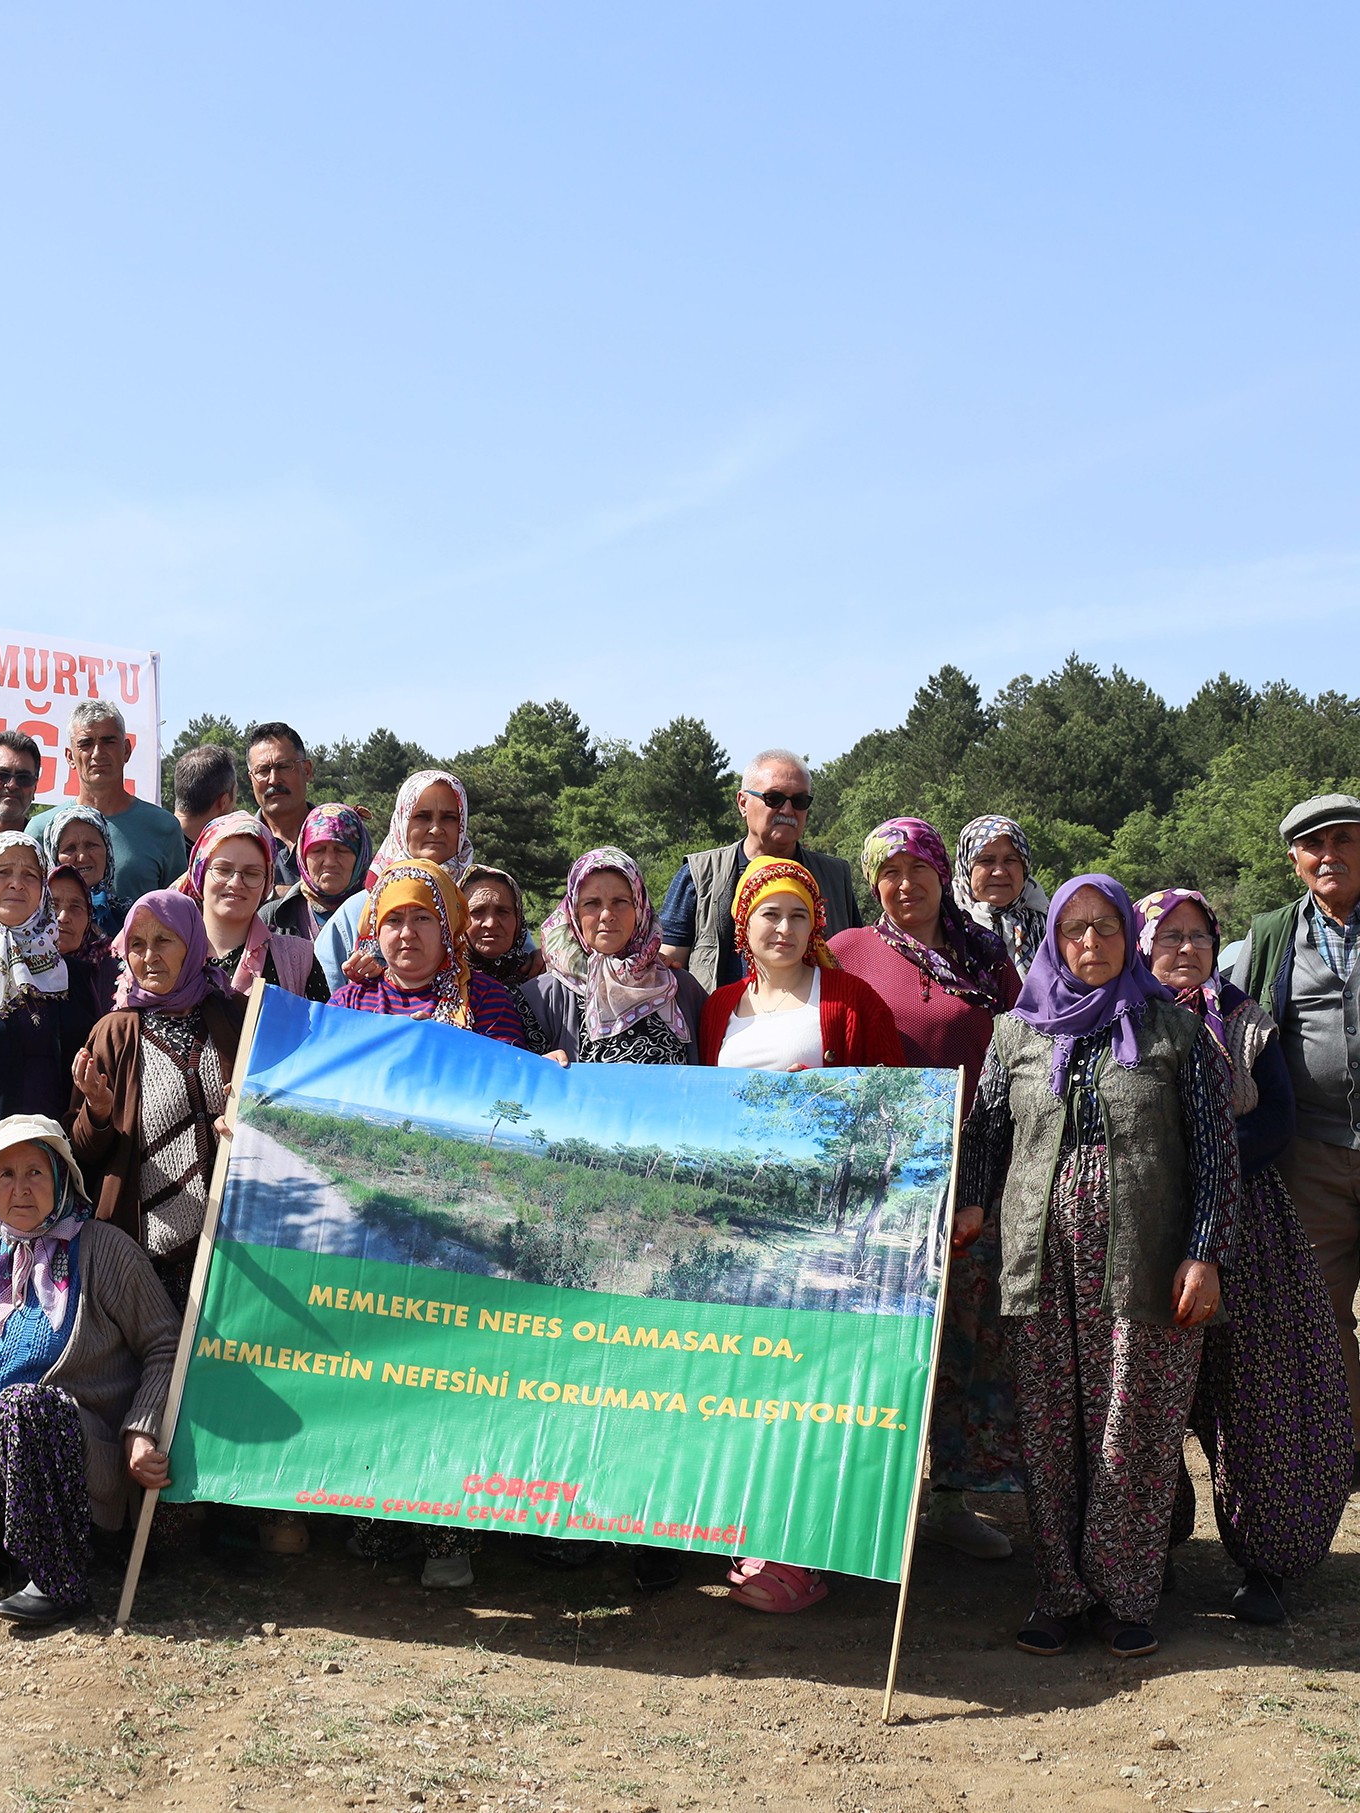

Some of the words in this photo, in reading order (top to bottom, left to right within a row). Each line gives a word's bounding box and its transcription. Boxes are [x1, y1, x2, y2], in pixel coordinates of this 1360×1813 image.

[308, 1284, 469, 1327] MEMLEKETE
[478, 1309, 563, 1339] NEFES
[573, 1321, 742, 1356] OLAMASAK
[752, 1337, 803, 1362] DA,
[197, 1337, 373, 1381] MEMLEKETİN
[383, 1363, 509, 1397] NEFESİNİ
[518, 1379, 687, 1413] KORUMAYA
[698, 1395, 908, 1431] ÇALIŞIYORUZ.
[295, 1488, 377, 1510] GÖRDES
[381, 1497, 462, 1518] ÇEVRESİ
[466, 1505, 529, 1524] ÇEVRE
[535, 1510, 561, 1527] VE
[566, 1511, 646, 1535] KÜLTÜR
[651, 1520, 747, 1545] DERNEĞİ
[461, 1472, 583, 1506] GÖRÇEV
